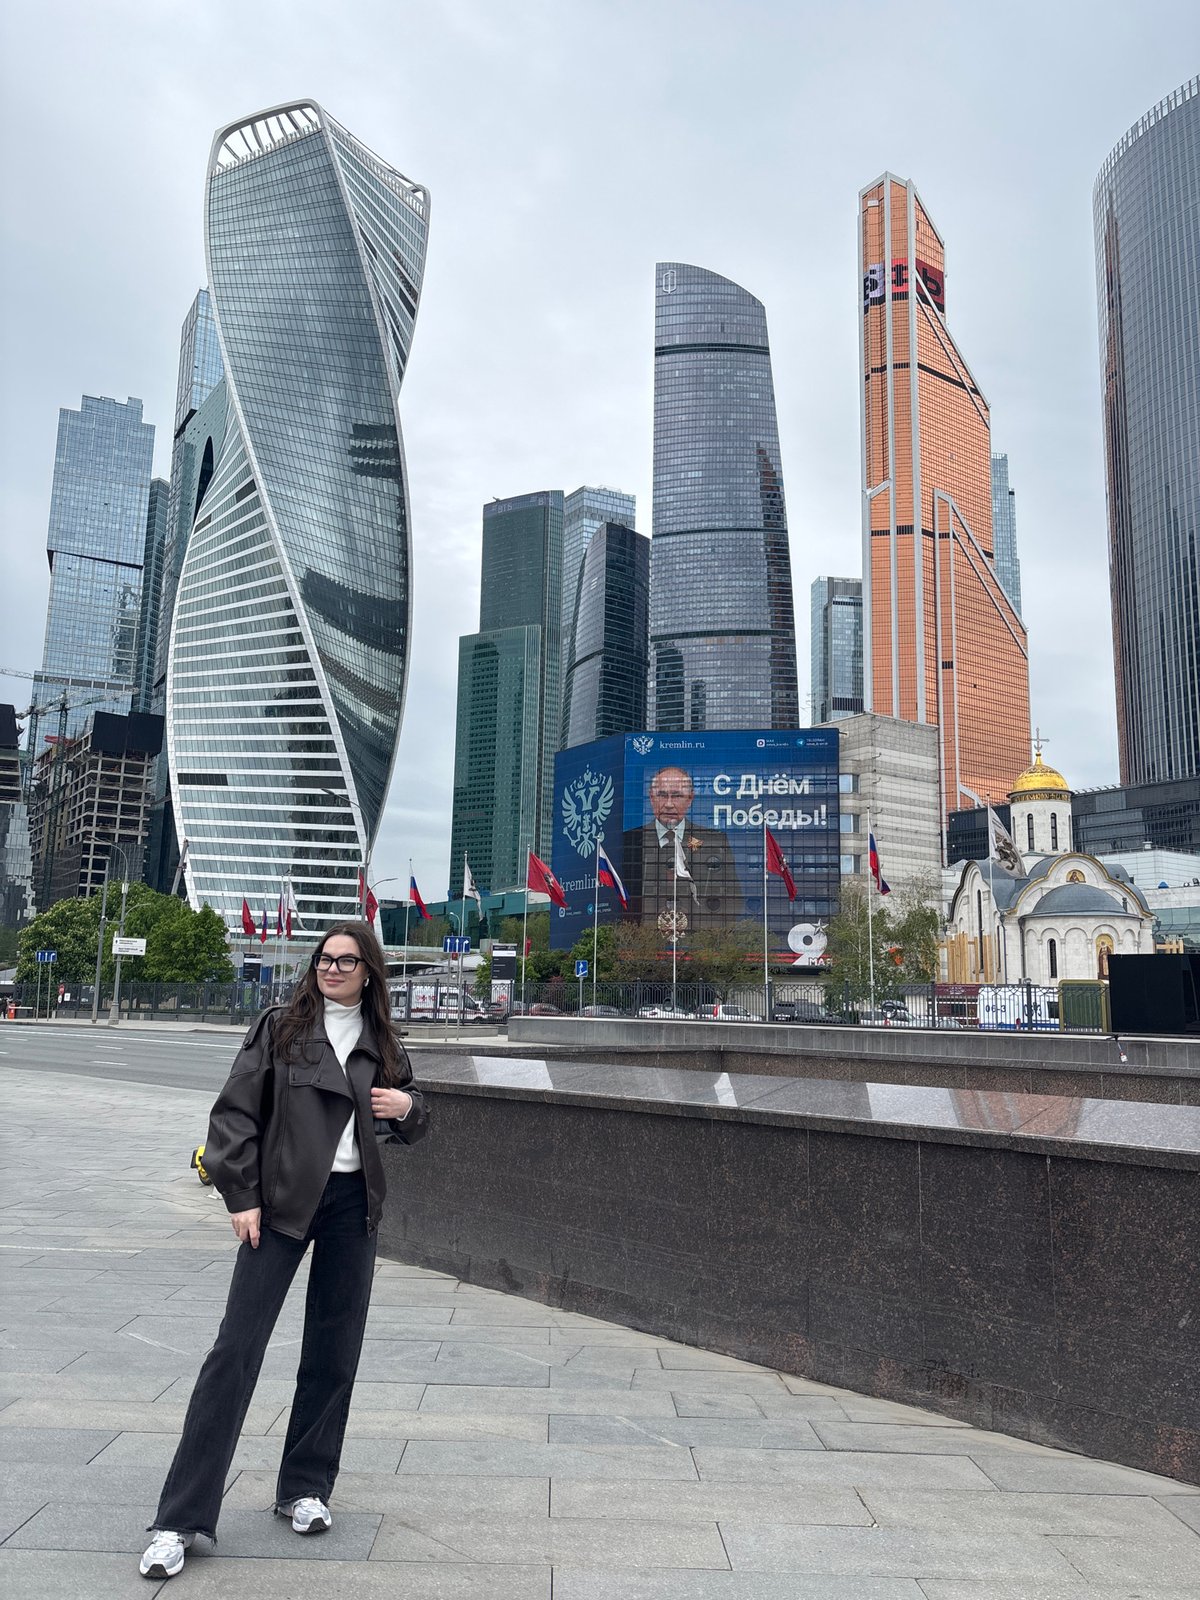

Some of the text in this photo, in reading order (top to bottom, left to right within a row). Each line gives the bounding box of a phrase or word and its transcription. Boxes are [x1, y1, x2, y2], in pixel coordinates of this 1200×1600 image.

[659, 740, 705, 749] kremlin.ru
[713, 774, 810, 800] С Днём
[713, 803, 827, 830] Победы!
[787, 922, 828, 966] 9
